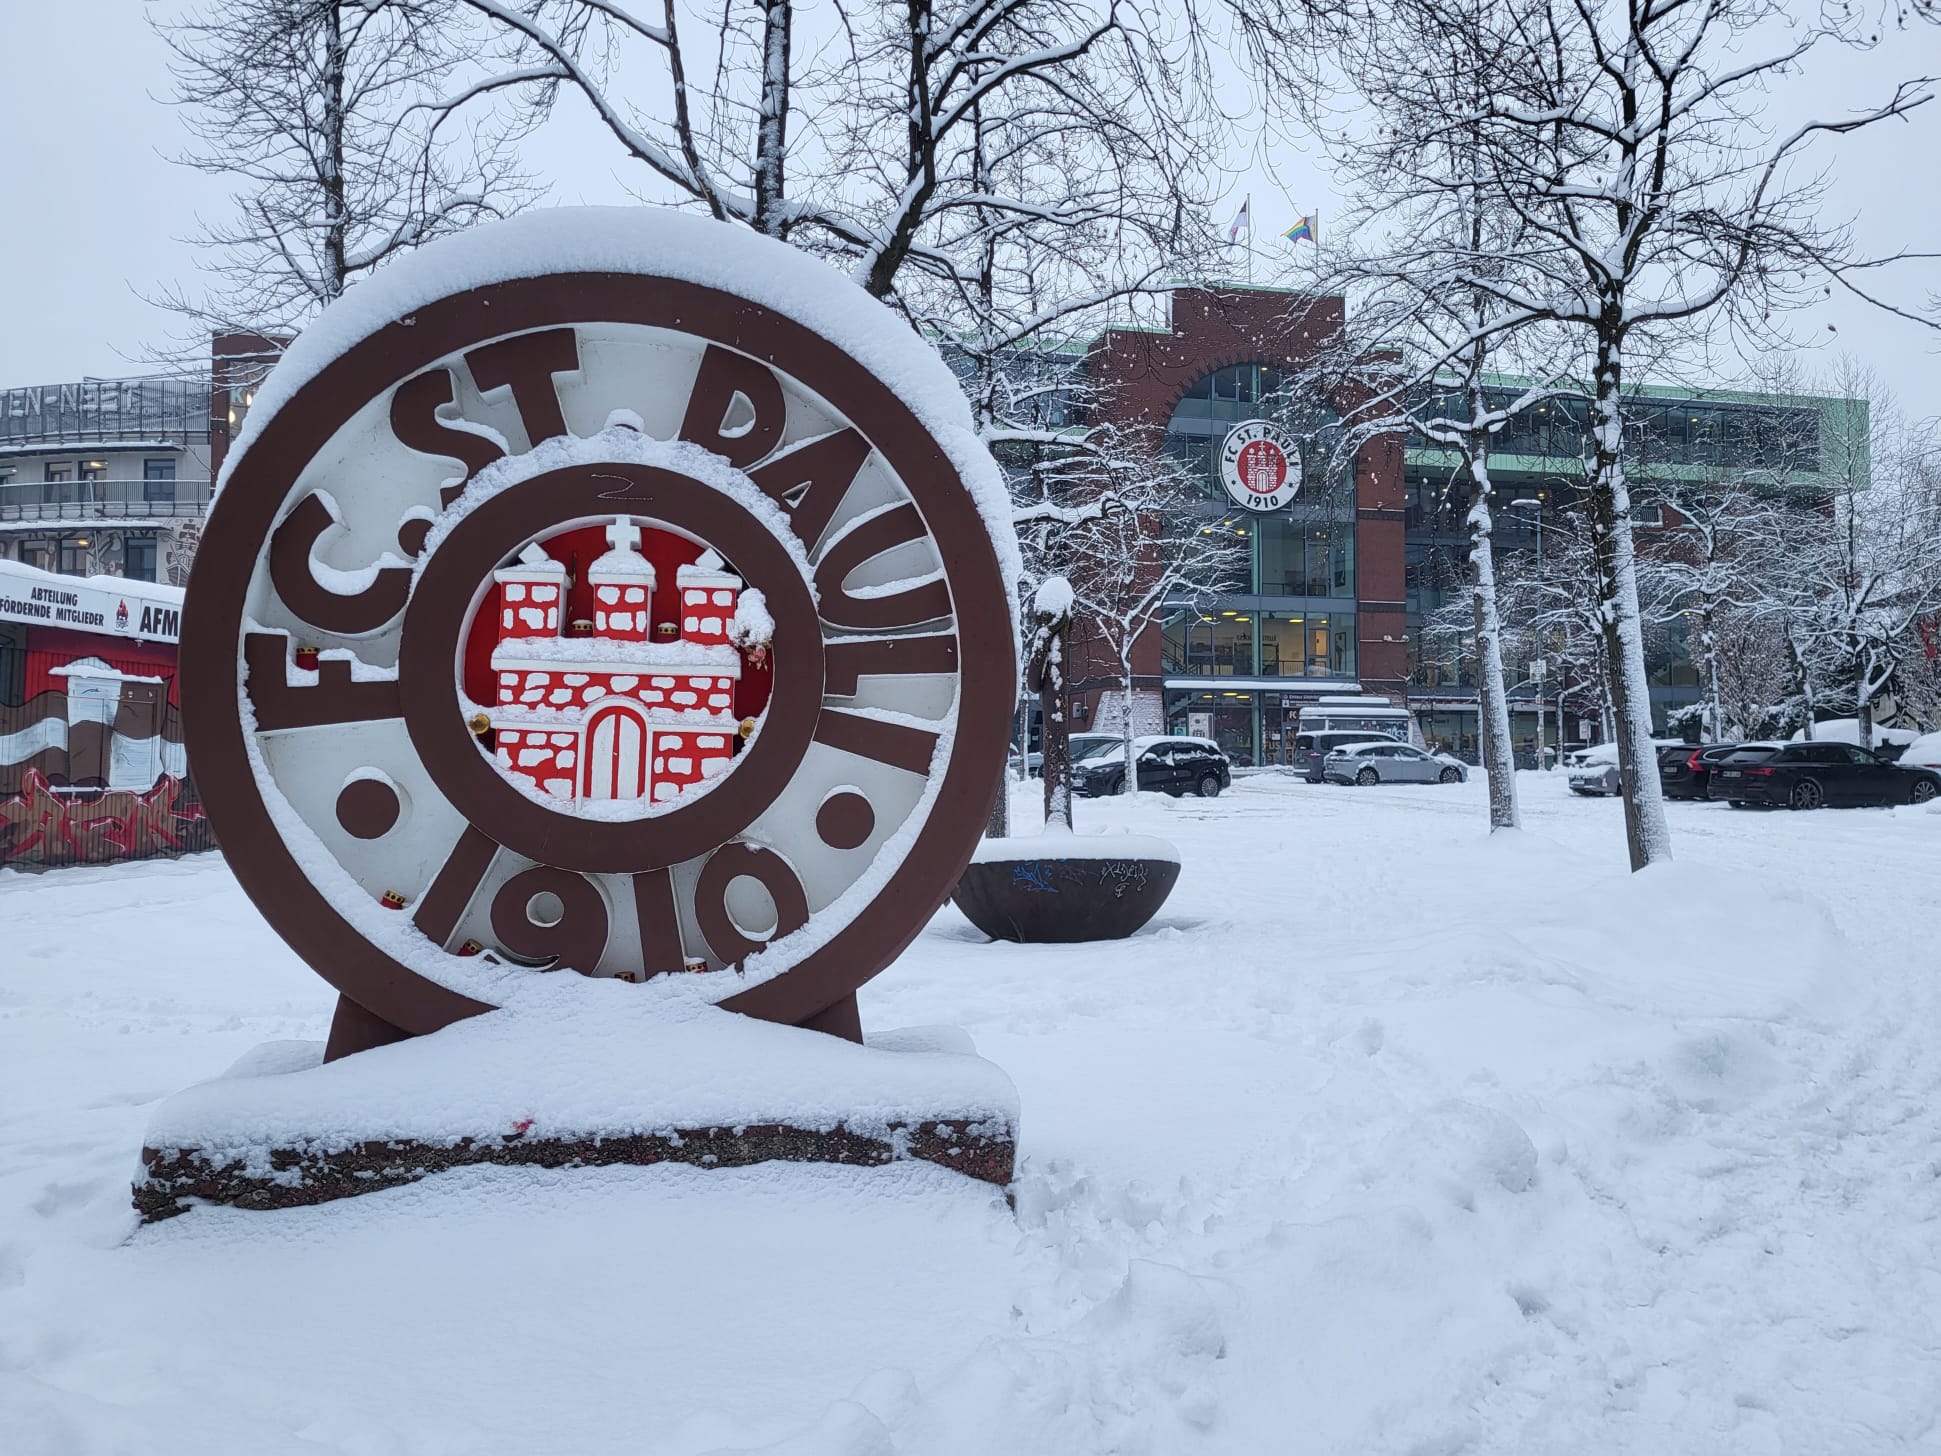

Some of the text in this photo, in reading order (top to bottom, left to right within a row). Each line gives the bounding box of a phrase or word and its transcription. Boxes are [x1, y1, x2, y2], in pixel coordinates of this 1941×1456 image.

[1225, 427, 1299, 466] FC ST. PAULI
[1247, 494, 1279, 508] 1910
[390, 328, 642, 512] ST
[679, 344, 958, 778] PAULI
[0, 595, 51, 619] FÖRDERNDE
[56, 608, 104, 627] MITGLIEDER
[31, 587, 78, 606] ABTEILUNG
[140, 606, 178, 637] AFM
[413, 822, 810, 982] 1910
